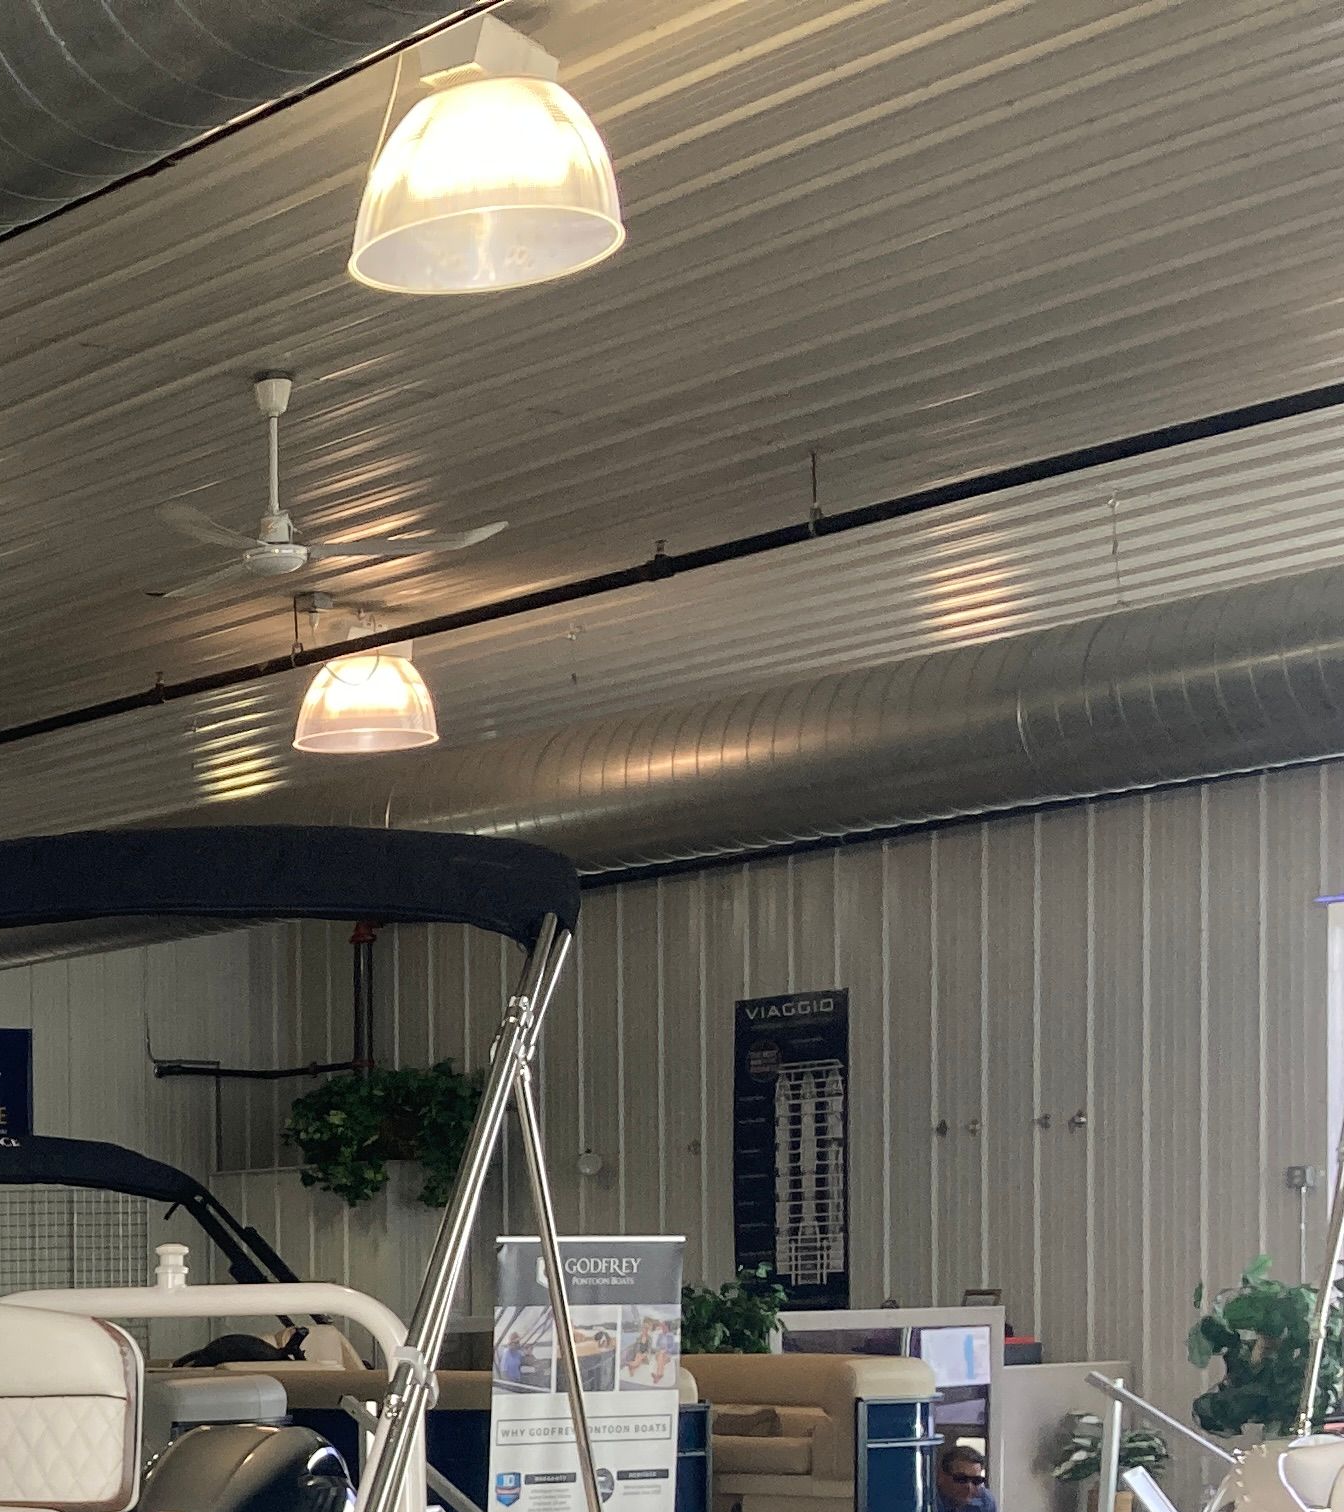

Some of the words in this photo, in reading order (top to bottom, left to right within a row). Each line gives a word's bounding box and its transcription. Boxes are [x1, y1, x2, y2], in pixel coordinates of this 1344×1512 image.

[745, 999, 834, 1019] VIAGGIO
[564, 1257, 642, 1276] GODFREY
[501, 1428, 525, 1438] WHY
[634, 1424, 667, 1433] BOATS
